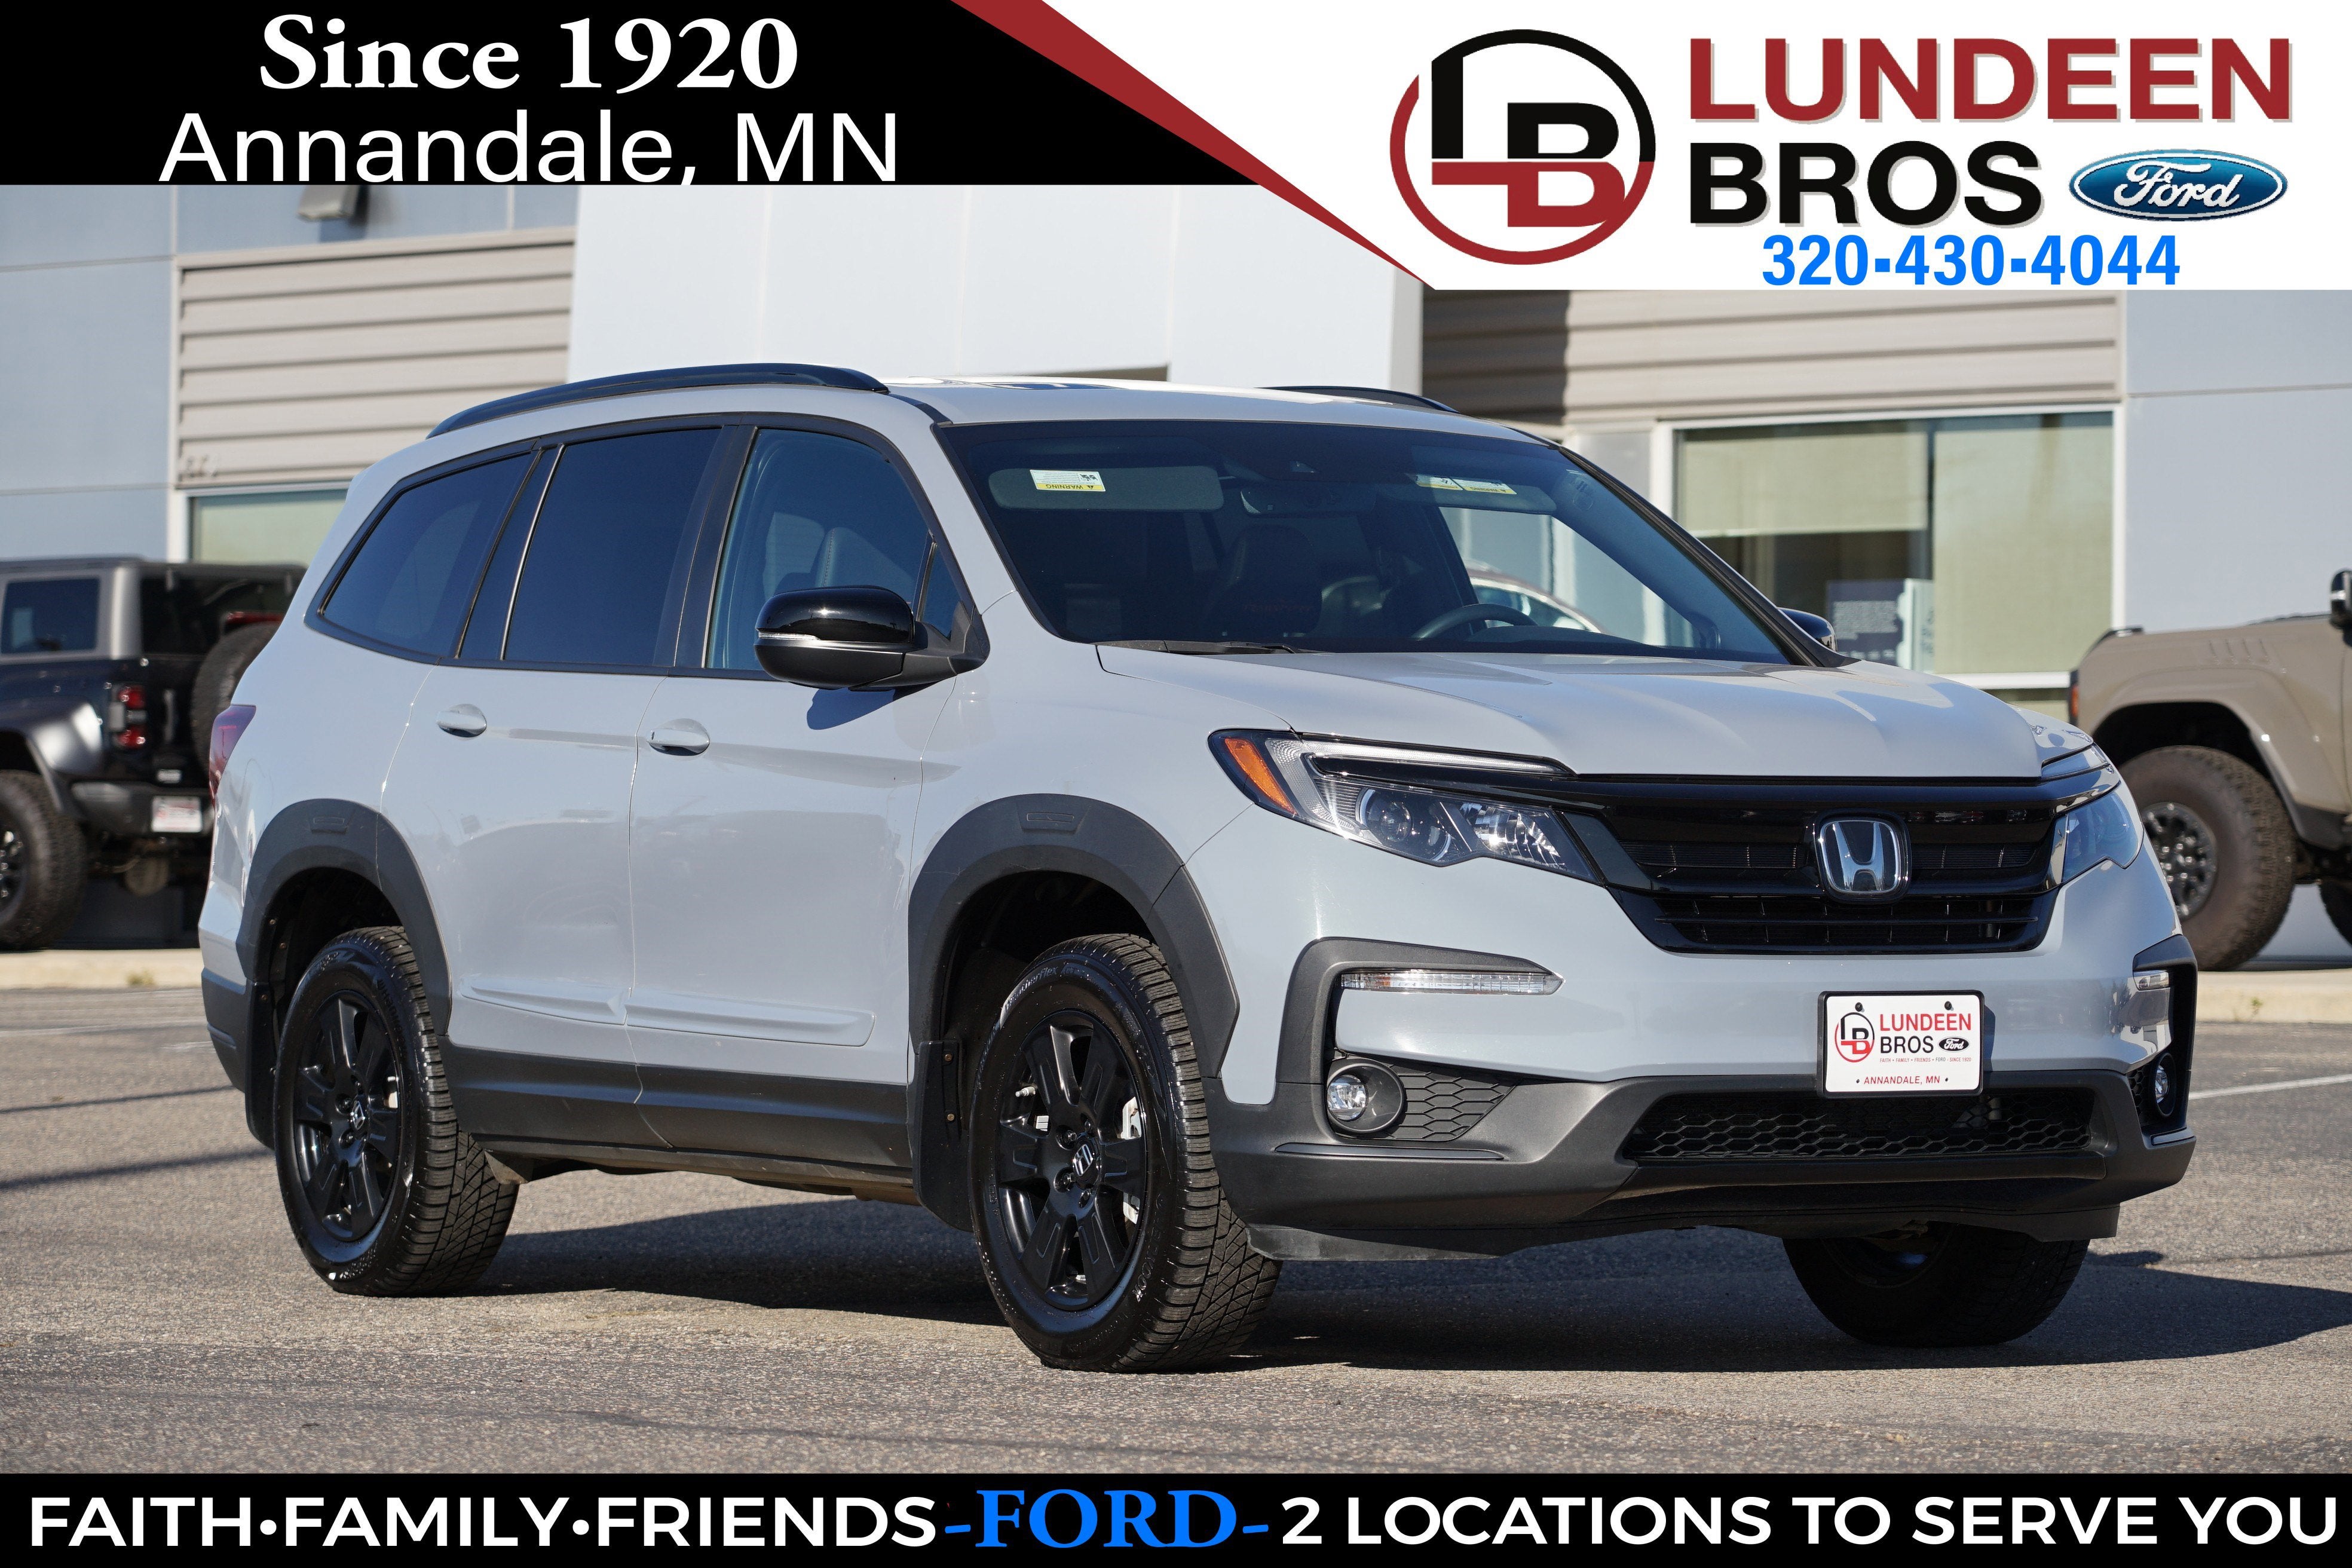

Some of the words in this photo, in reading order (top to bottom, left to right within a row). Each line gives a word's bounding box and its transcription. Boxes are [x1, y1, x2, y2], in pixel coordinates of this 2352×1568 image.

[1880, 1013, 1971, 1031] LUNDEEN
[1881, 1035, 1934, 1054] BROS
[1943, 1038, 1964, 1050] Ford
[1863, 1076, 1922, 1085] ANNANDALE,
[1926, 1076, 1940, 1084] MN
